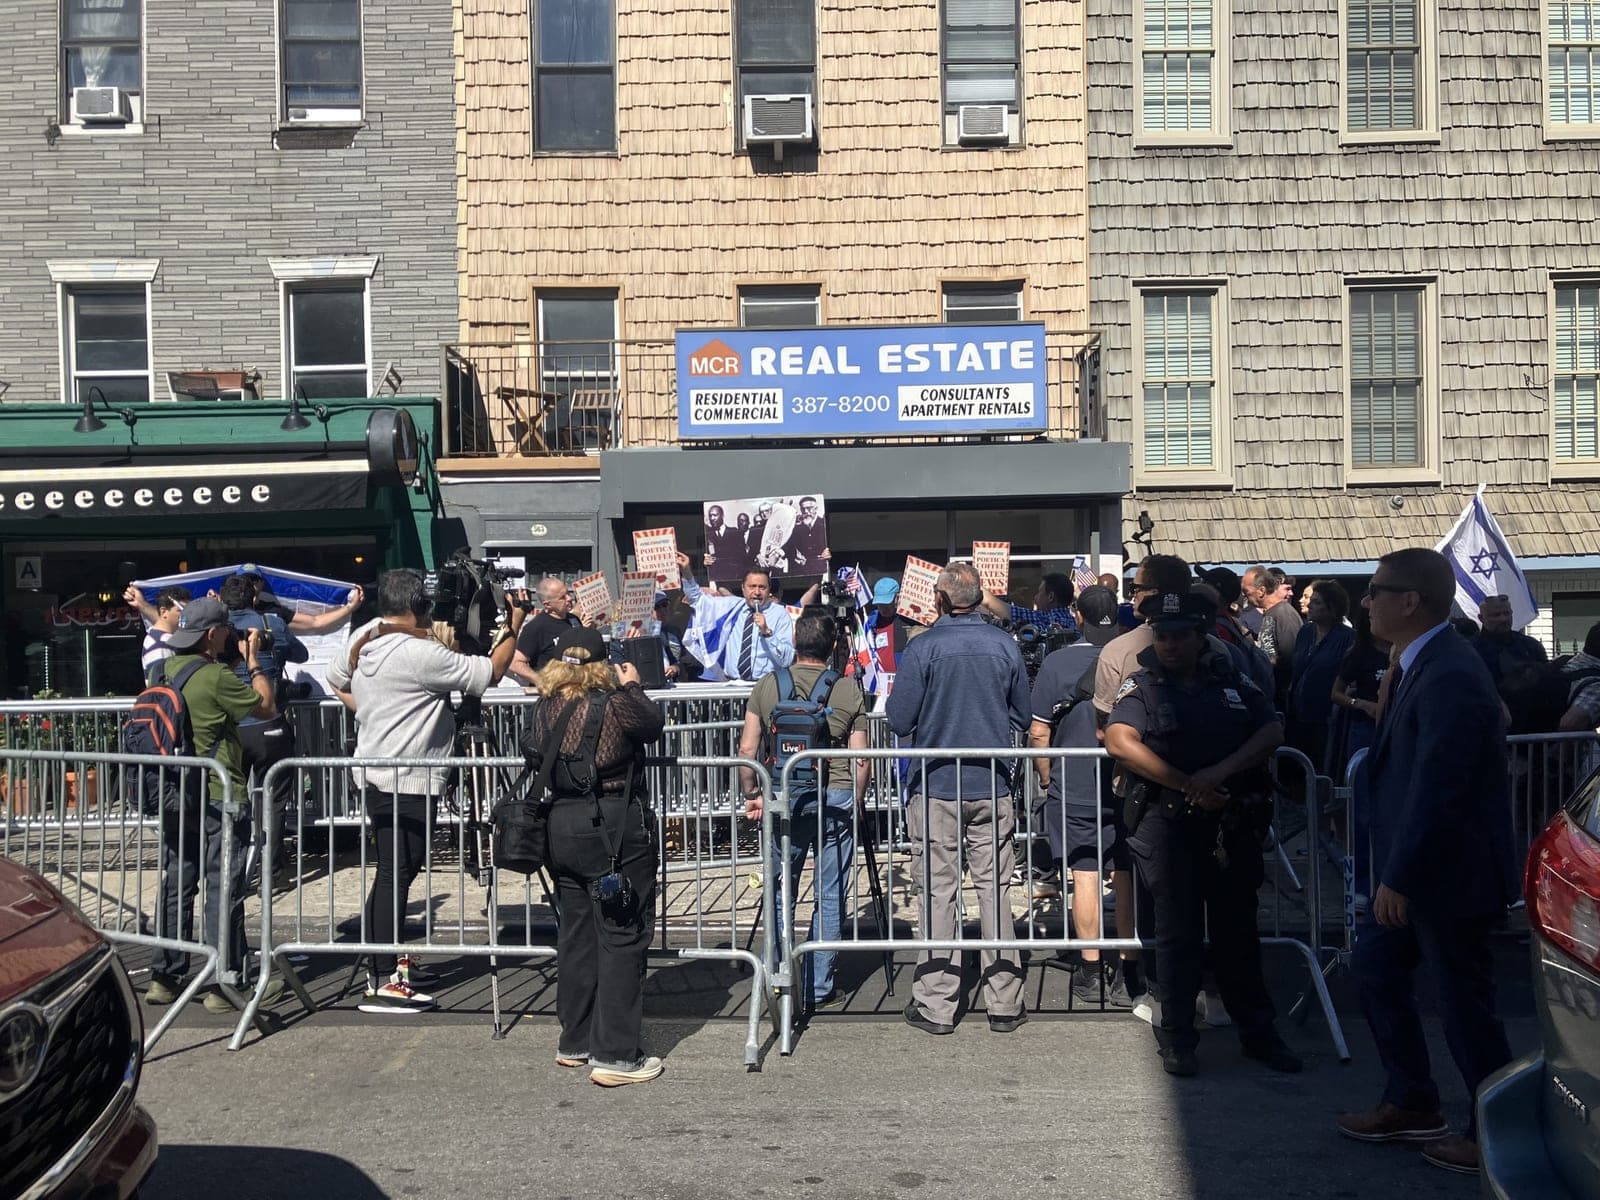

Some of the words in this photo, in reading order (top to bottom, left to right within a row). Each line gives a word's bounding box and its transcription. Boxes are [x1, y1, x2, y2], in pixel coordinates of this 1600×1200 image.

[691, 356, 738, 374] MCR
[750, 346, 860, 375] REAL
[879, 340, 1034, 373] ESTATE
[695, 392, 778, 406] RESIDENTIAL
[920, 387, 1010, 402] CONSULTANTS
[791, 396, 890, 413] 387-8200
[902, 403, 975, 418] APARTMENT
[978, 401, 1031, 416] RENTALS
[694, 407, 778, 420] COMMERCIAL
[21, 561, 37, 578] A
[980, 578, 1005, 586] EWS
[1344, 858, 1354, 928] NYPD
